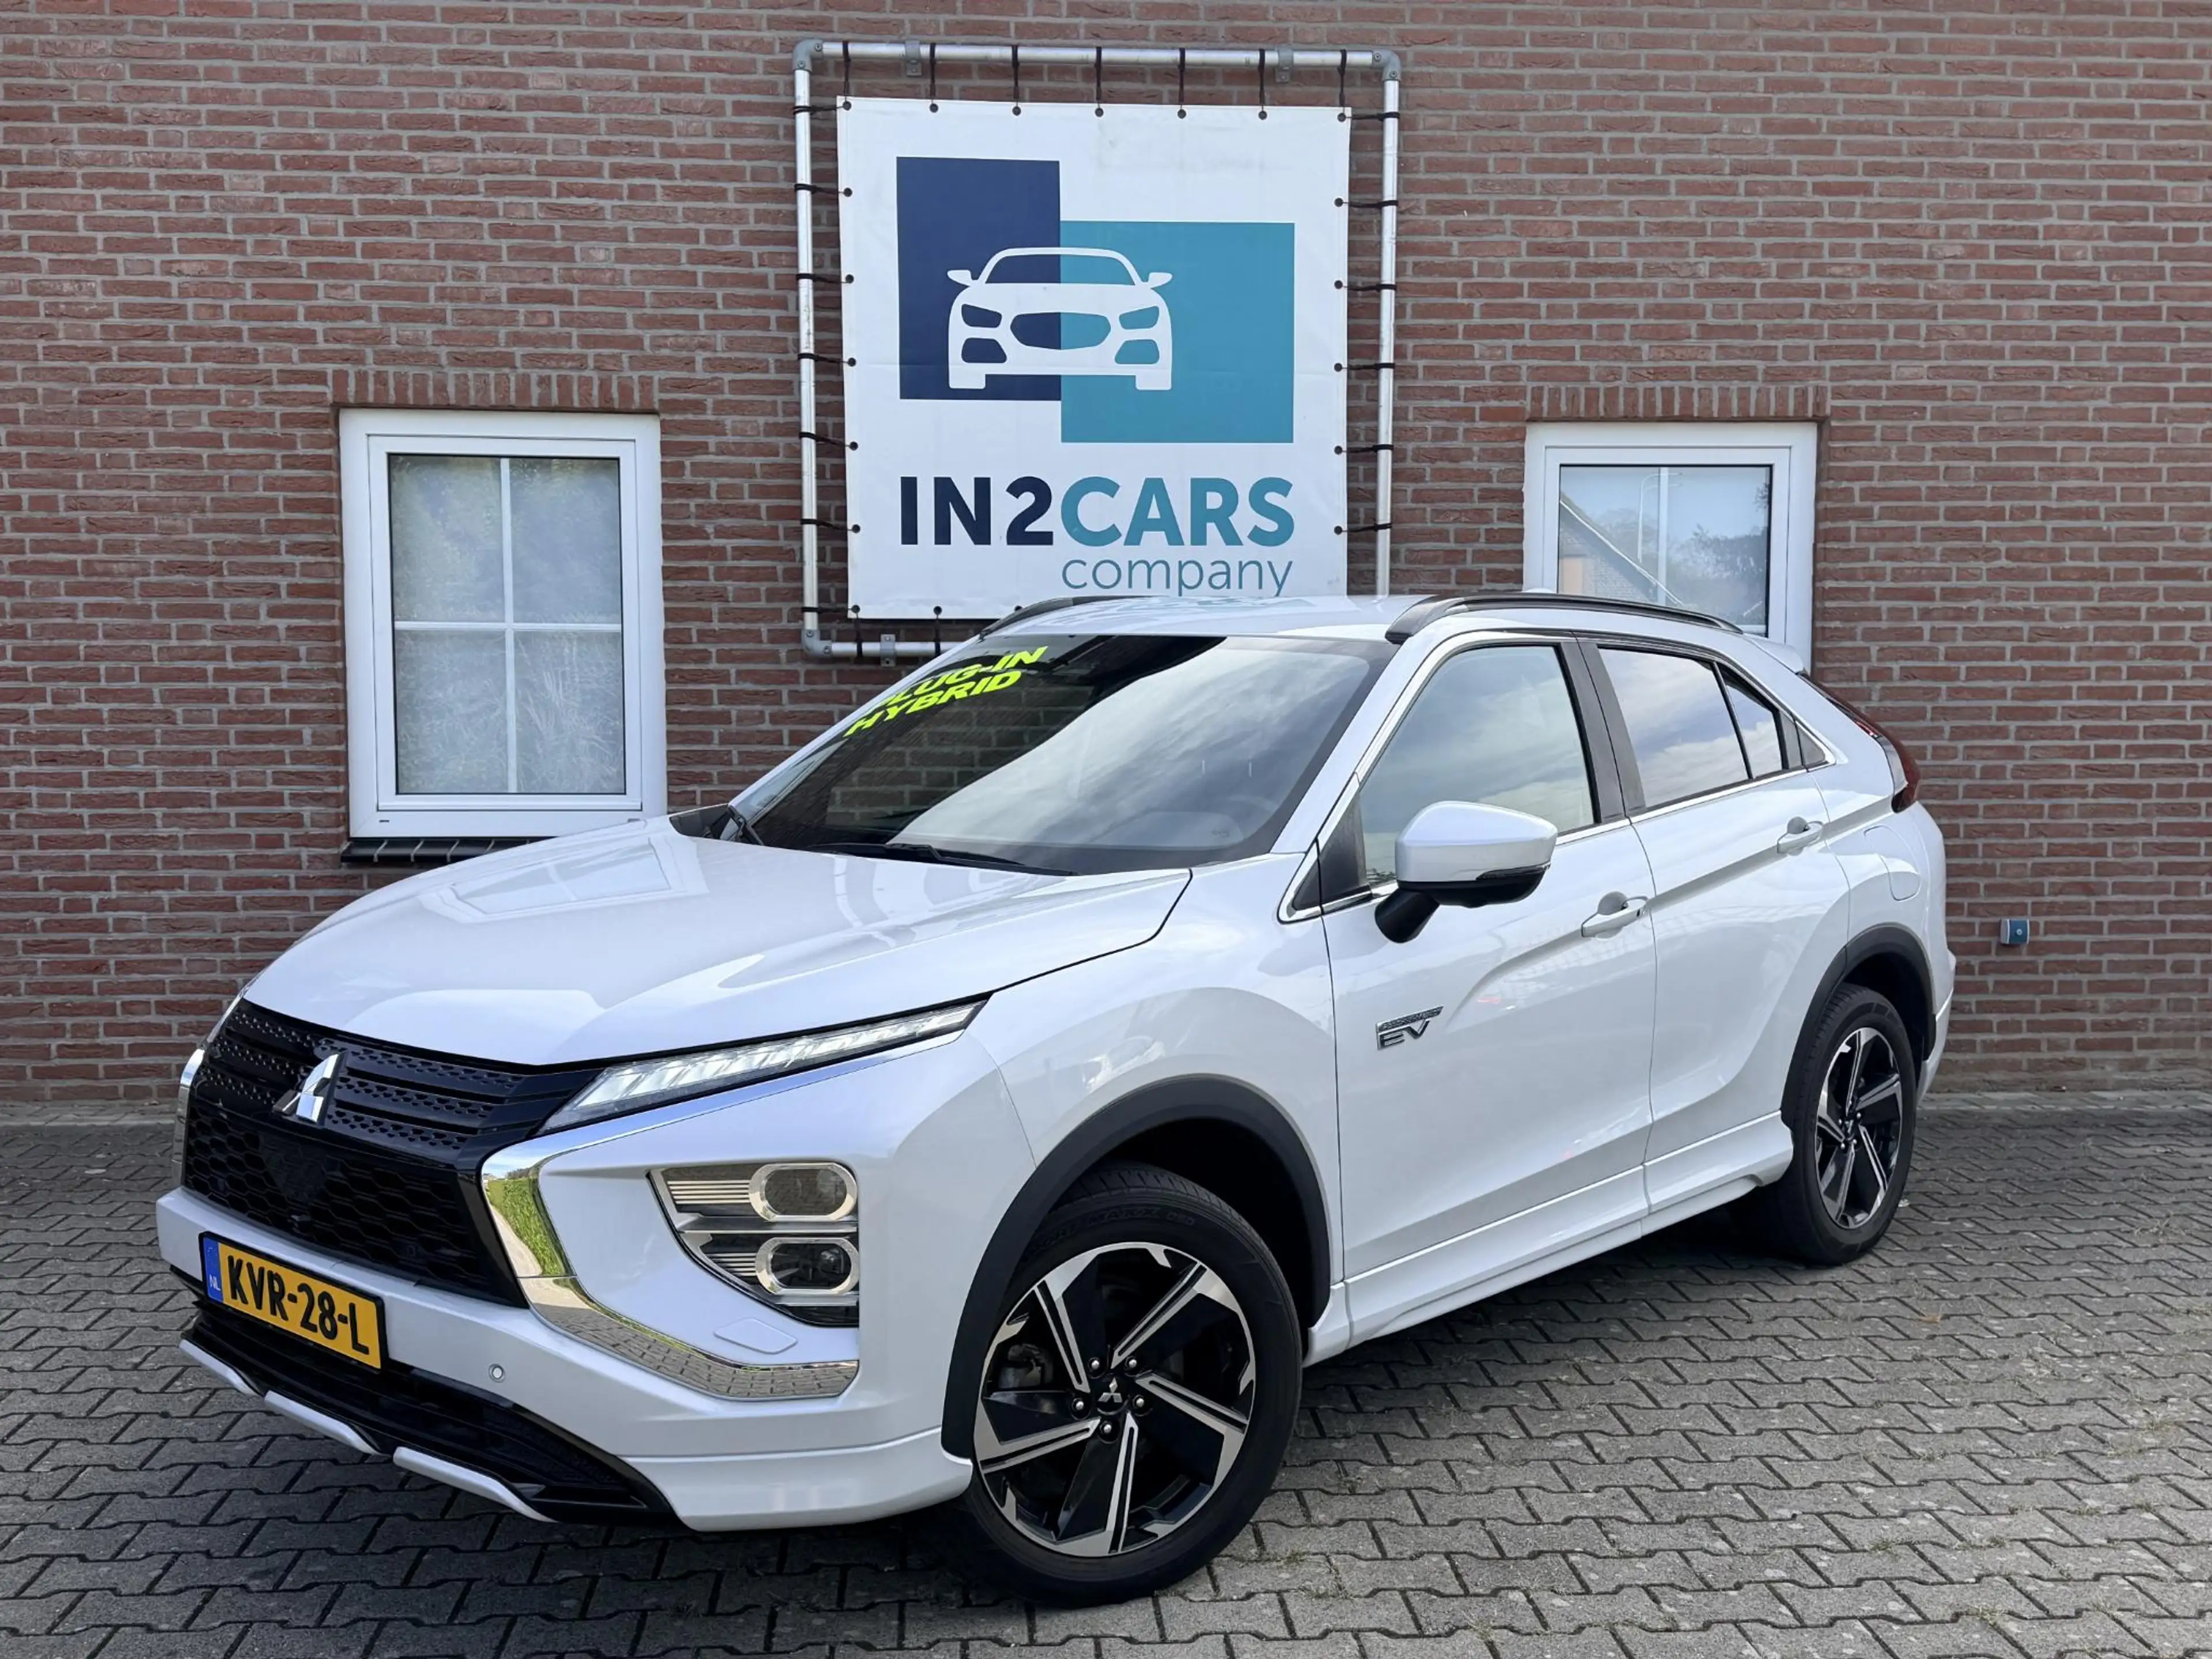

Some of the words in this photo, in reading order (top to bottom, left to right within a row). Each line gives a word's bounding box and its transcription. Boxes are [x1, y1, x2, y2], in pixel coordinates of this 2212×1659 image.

[900, 476, 1295, 547] IN2CARS
[1061, 559, 1294, 597] company
[842, 671, 1022, 738] HYBRID
[1376, 1018, 1431, 1050] EV
[227, 1255, 370, 1355] KVR-28-L
